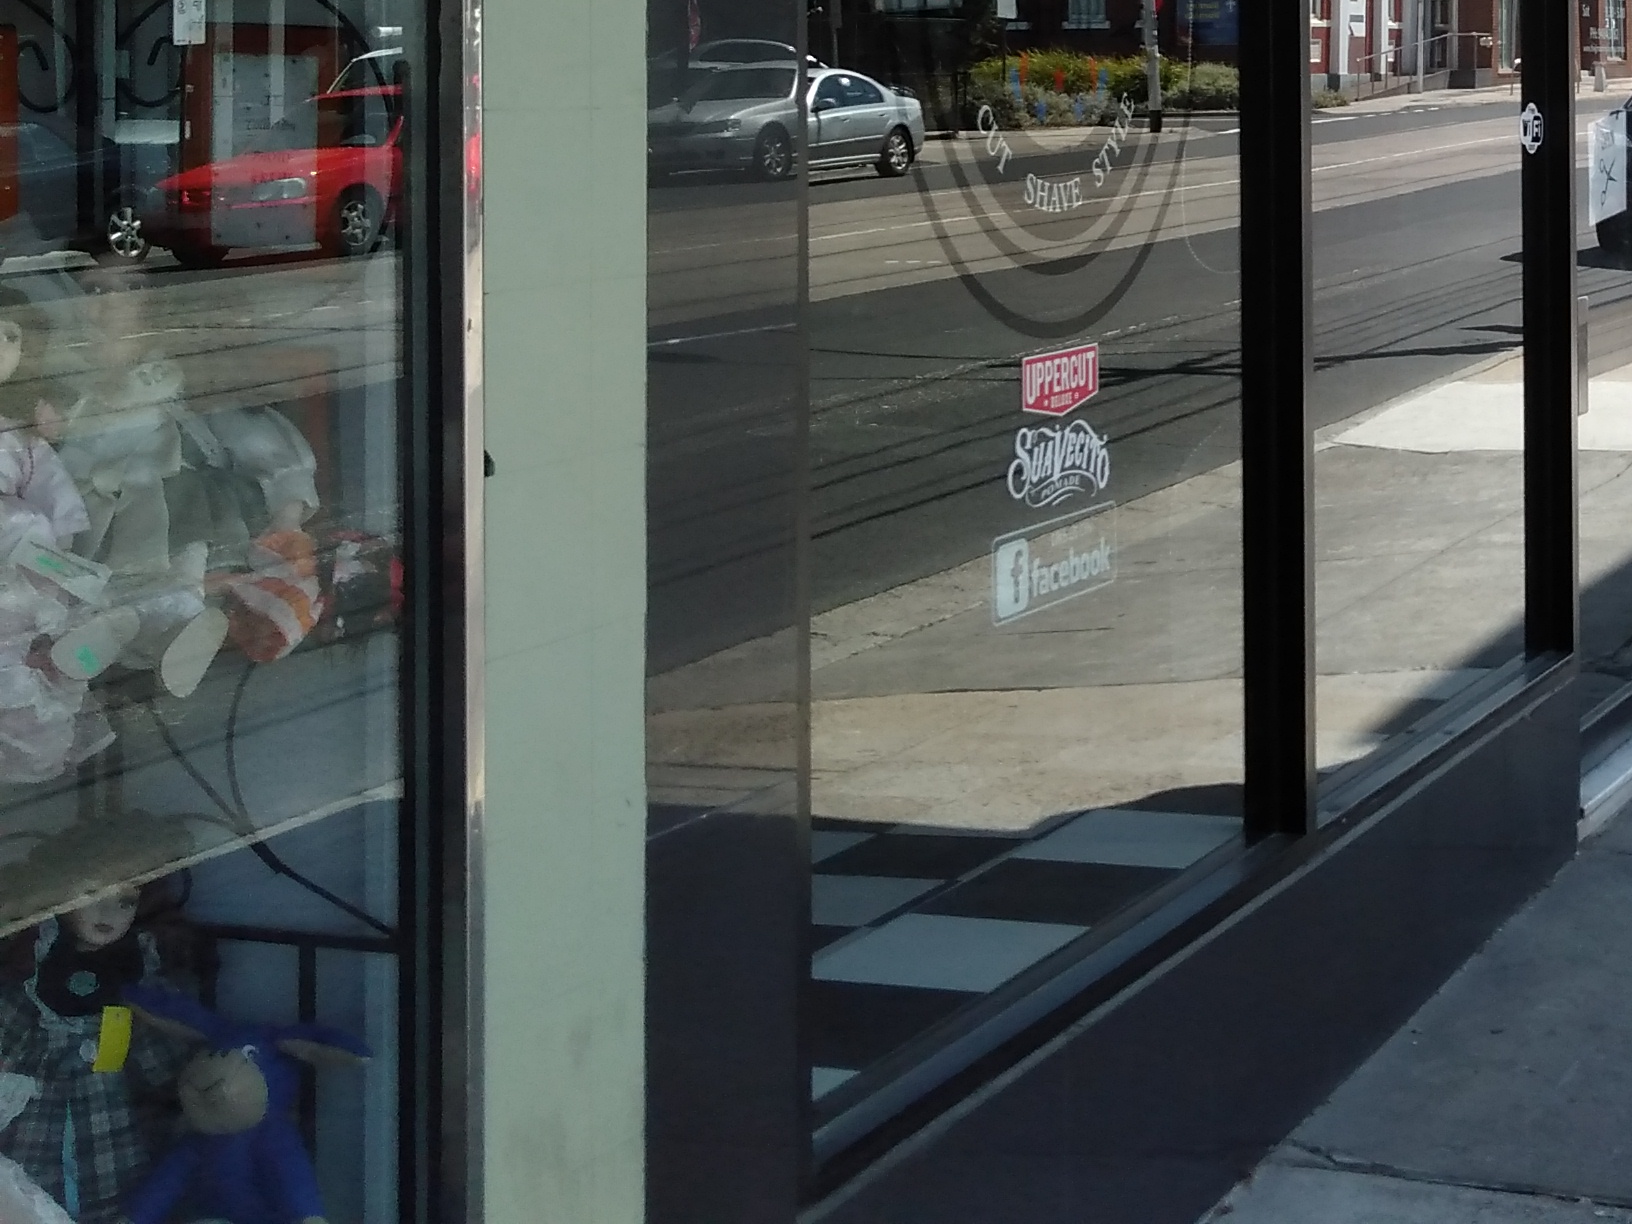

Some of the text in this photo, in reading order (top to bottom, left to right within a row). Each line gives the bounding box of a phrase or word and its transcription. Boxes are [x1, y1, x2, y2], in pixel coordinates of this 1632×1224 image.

[976, 91, 1136, 213] CUT SHAVE STYLE
[1025, 350, 1096, 406] UPPERCUT
[1040, 473, 1081, 499] POMADE
[1031, 536, 1111, 599] facebook
